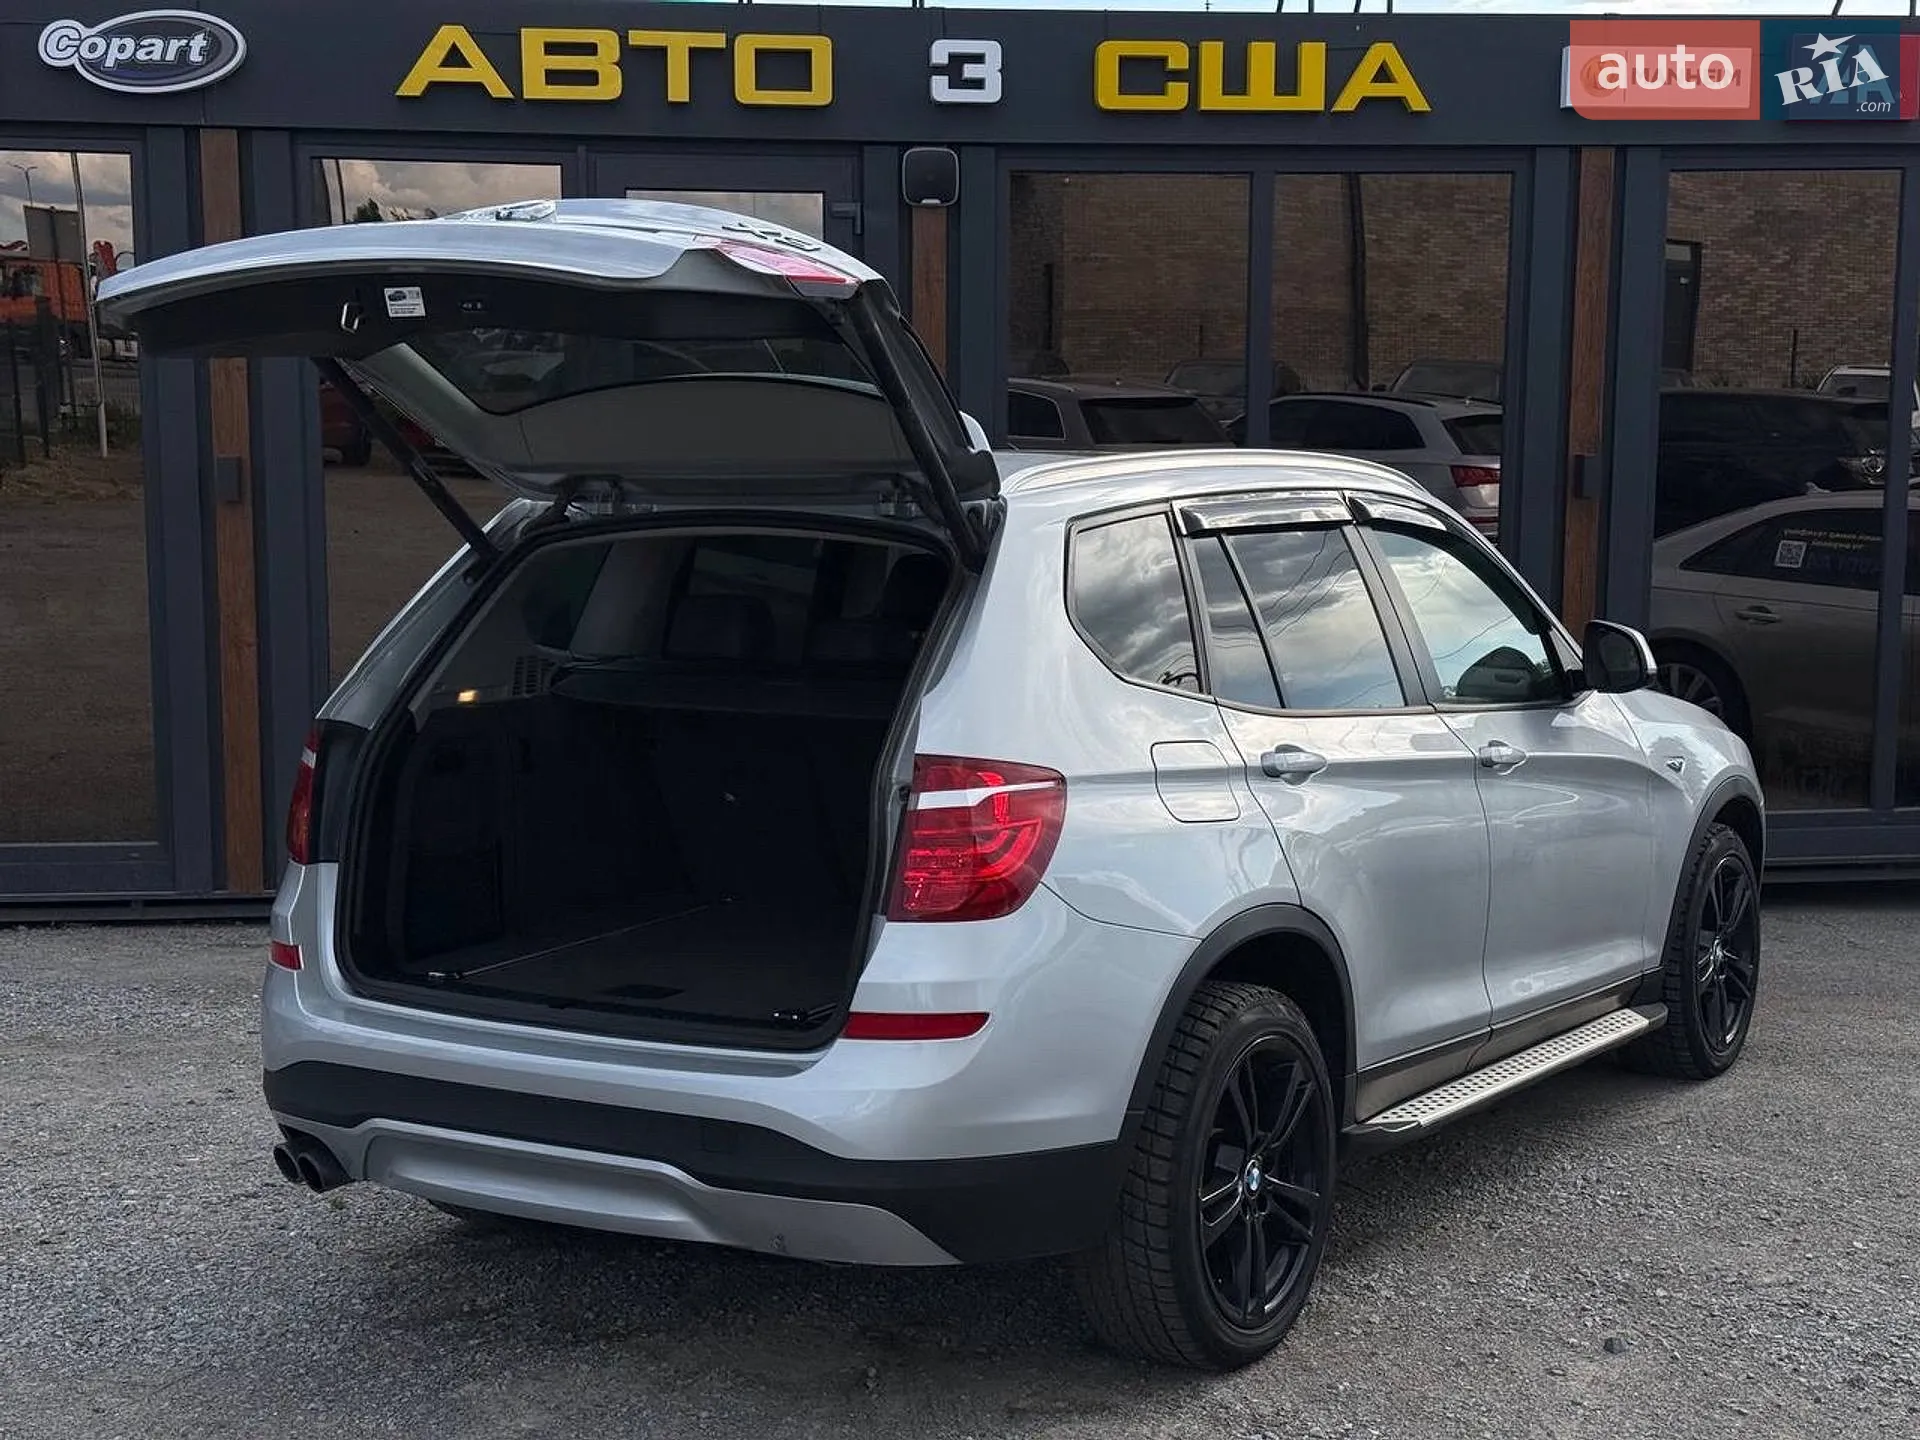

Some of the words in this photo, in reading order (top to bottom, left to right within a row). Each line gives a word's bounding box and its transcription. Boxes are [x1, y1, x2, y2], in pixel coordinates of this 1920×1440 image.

[45, 26, 209, 68] Copart
[395, 24, 834, 106] АВТО
[1094, 39, 1432, 112] США
